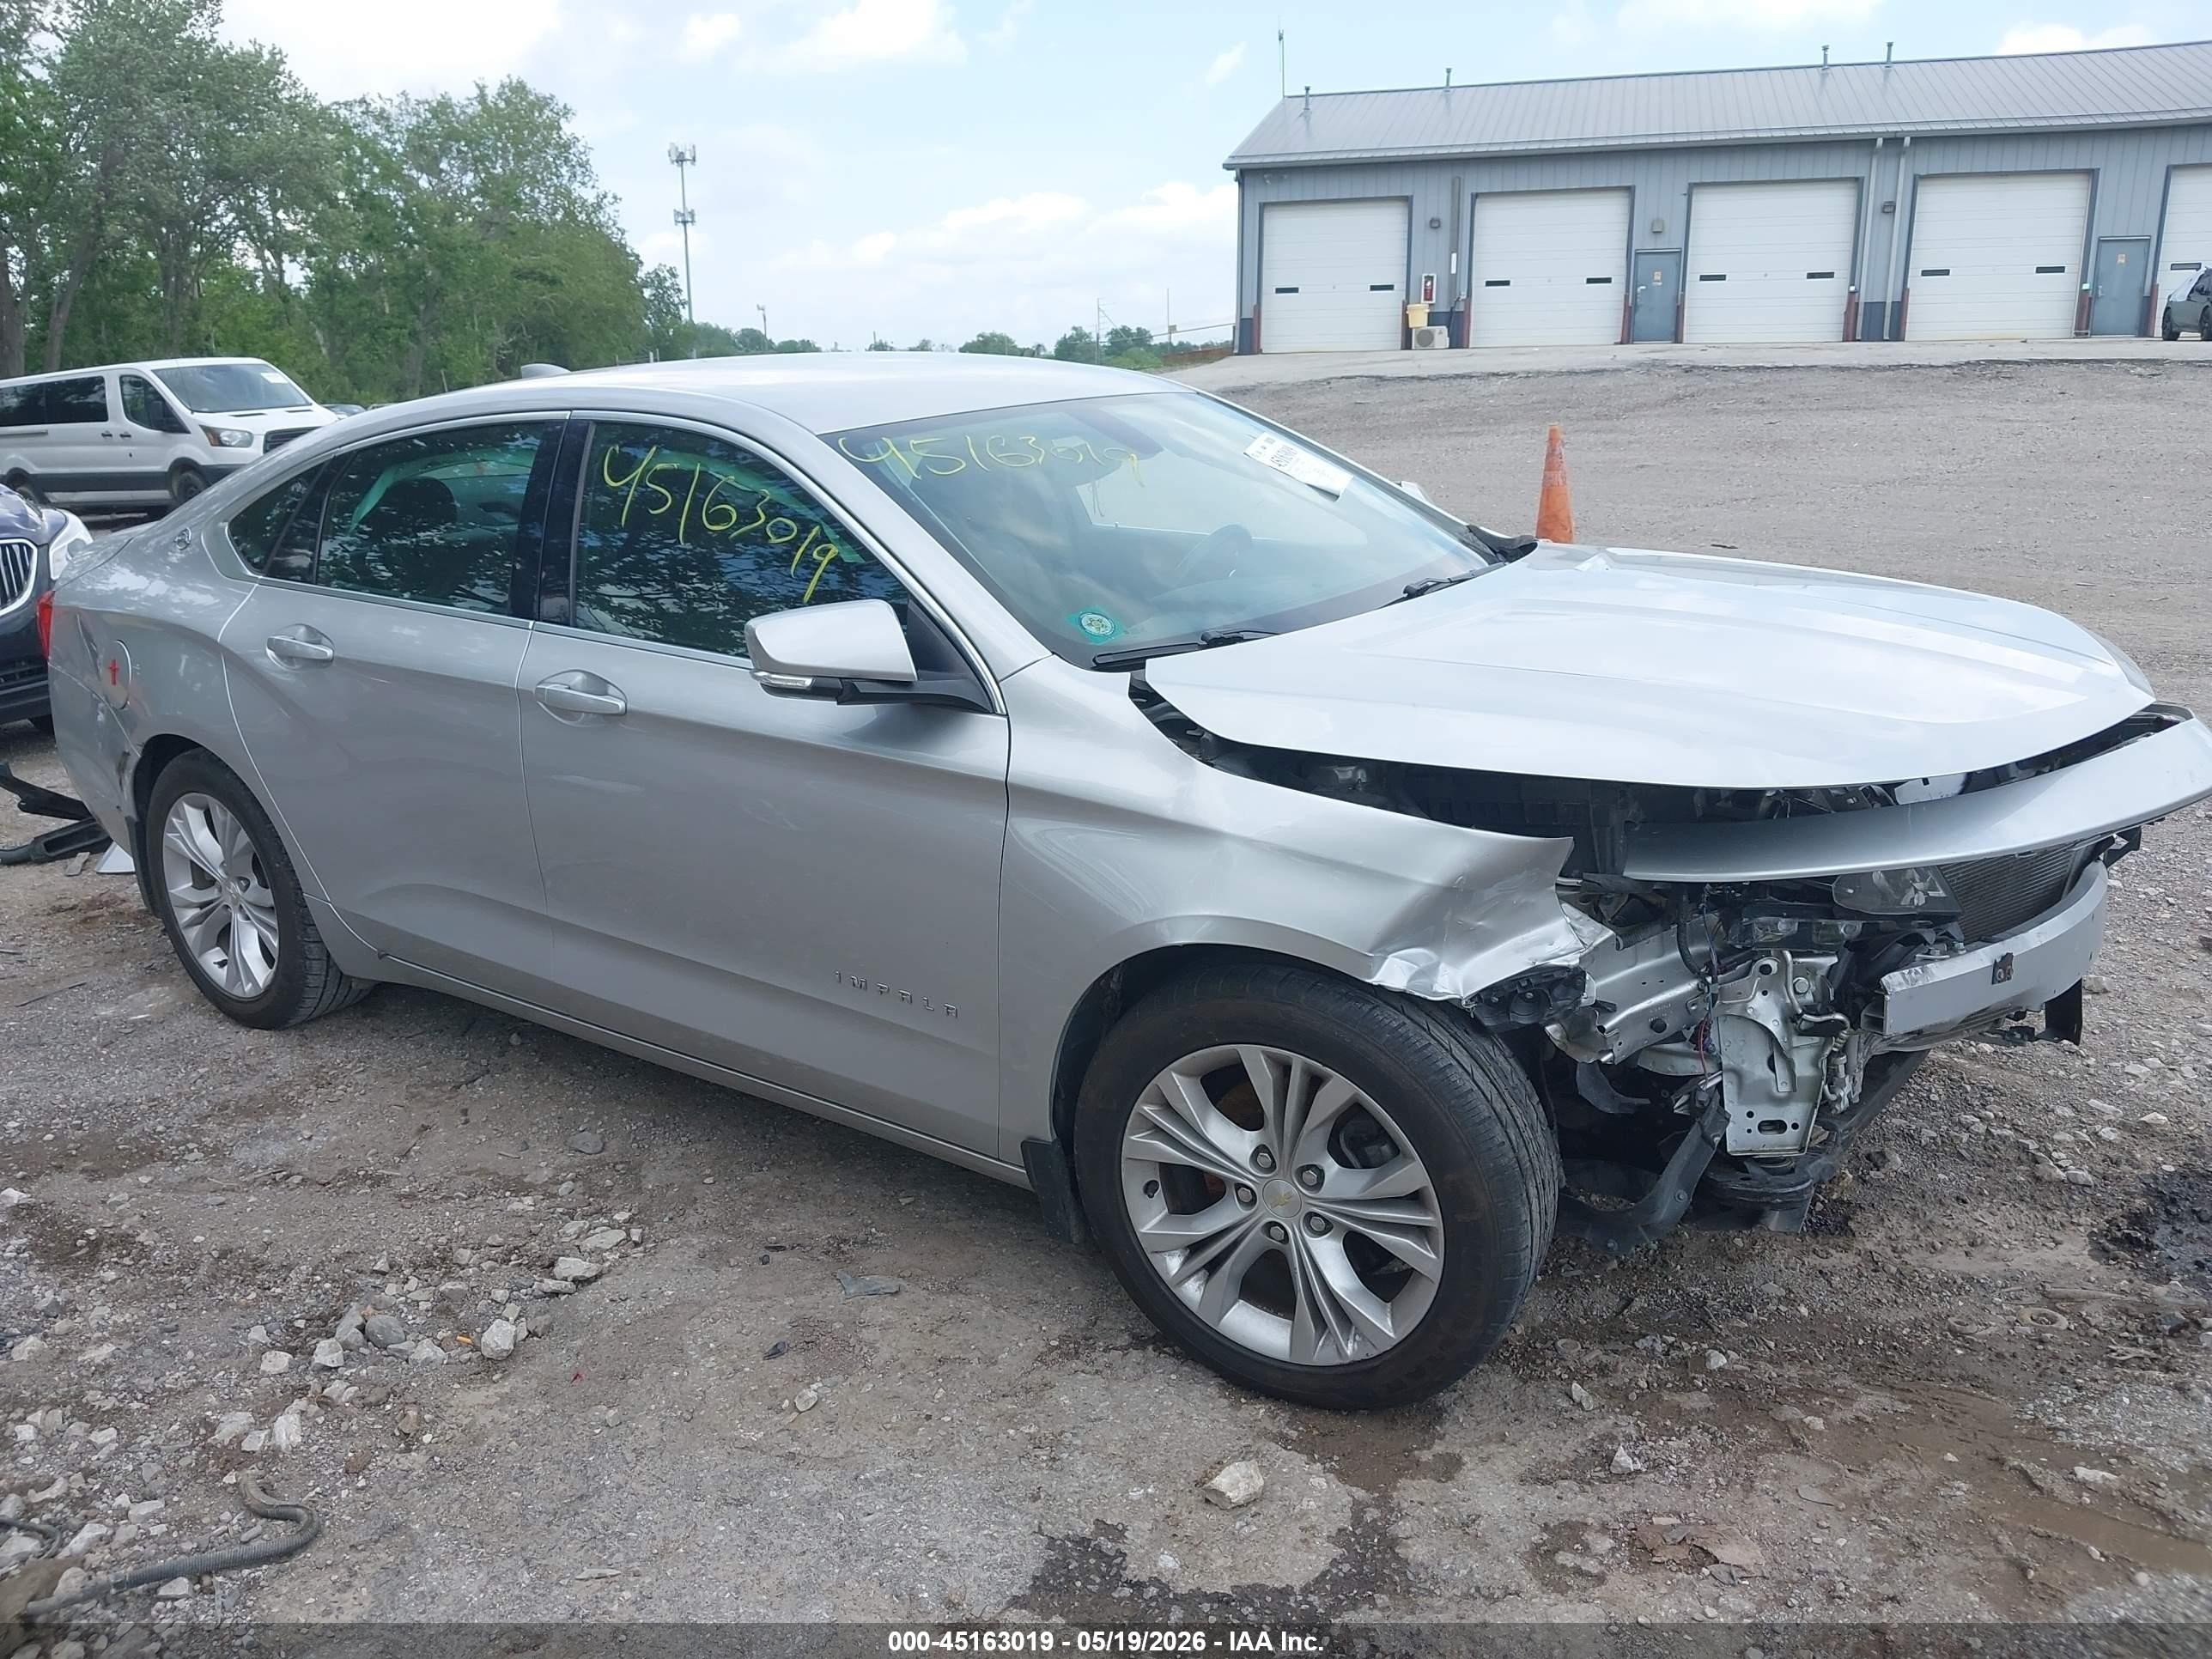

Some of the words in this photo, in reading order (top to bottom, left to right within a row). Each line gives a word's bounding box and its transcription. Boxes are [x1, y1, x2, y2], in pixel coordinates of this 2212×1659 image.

[837, 435, 1146, 487] 45163019
[604, 445, 839, 603] 45163019
[835, 970, 958, 1018] IMPALA
